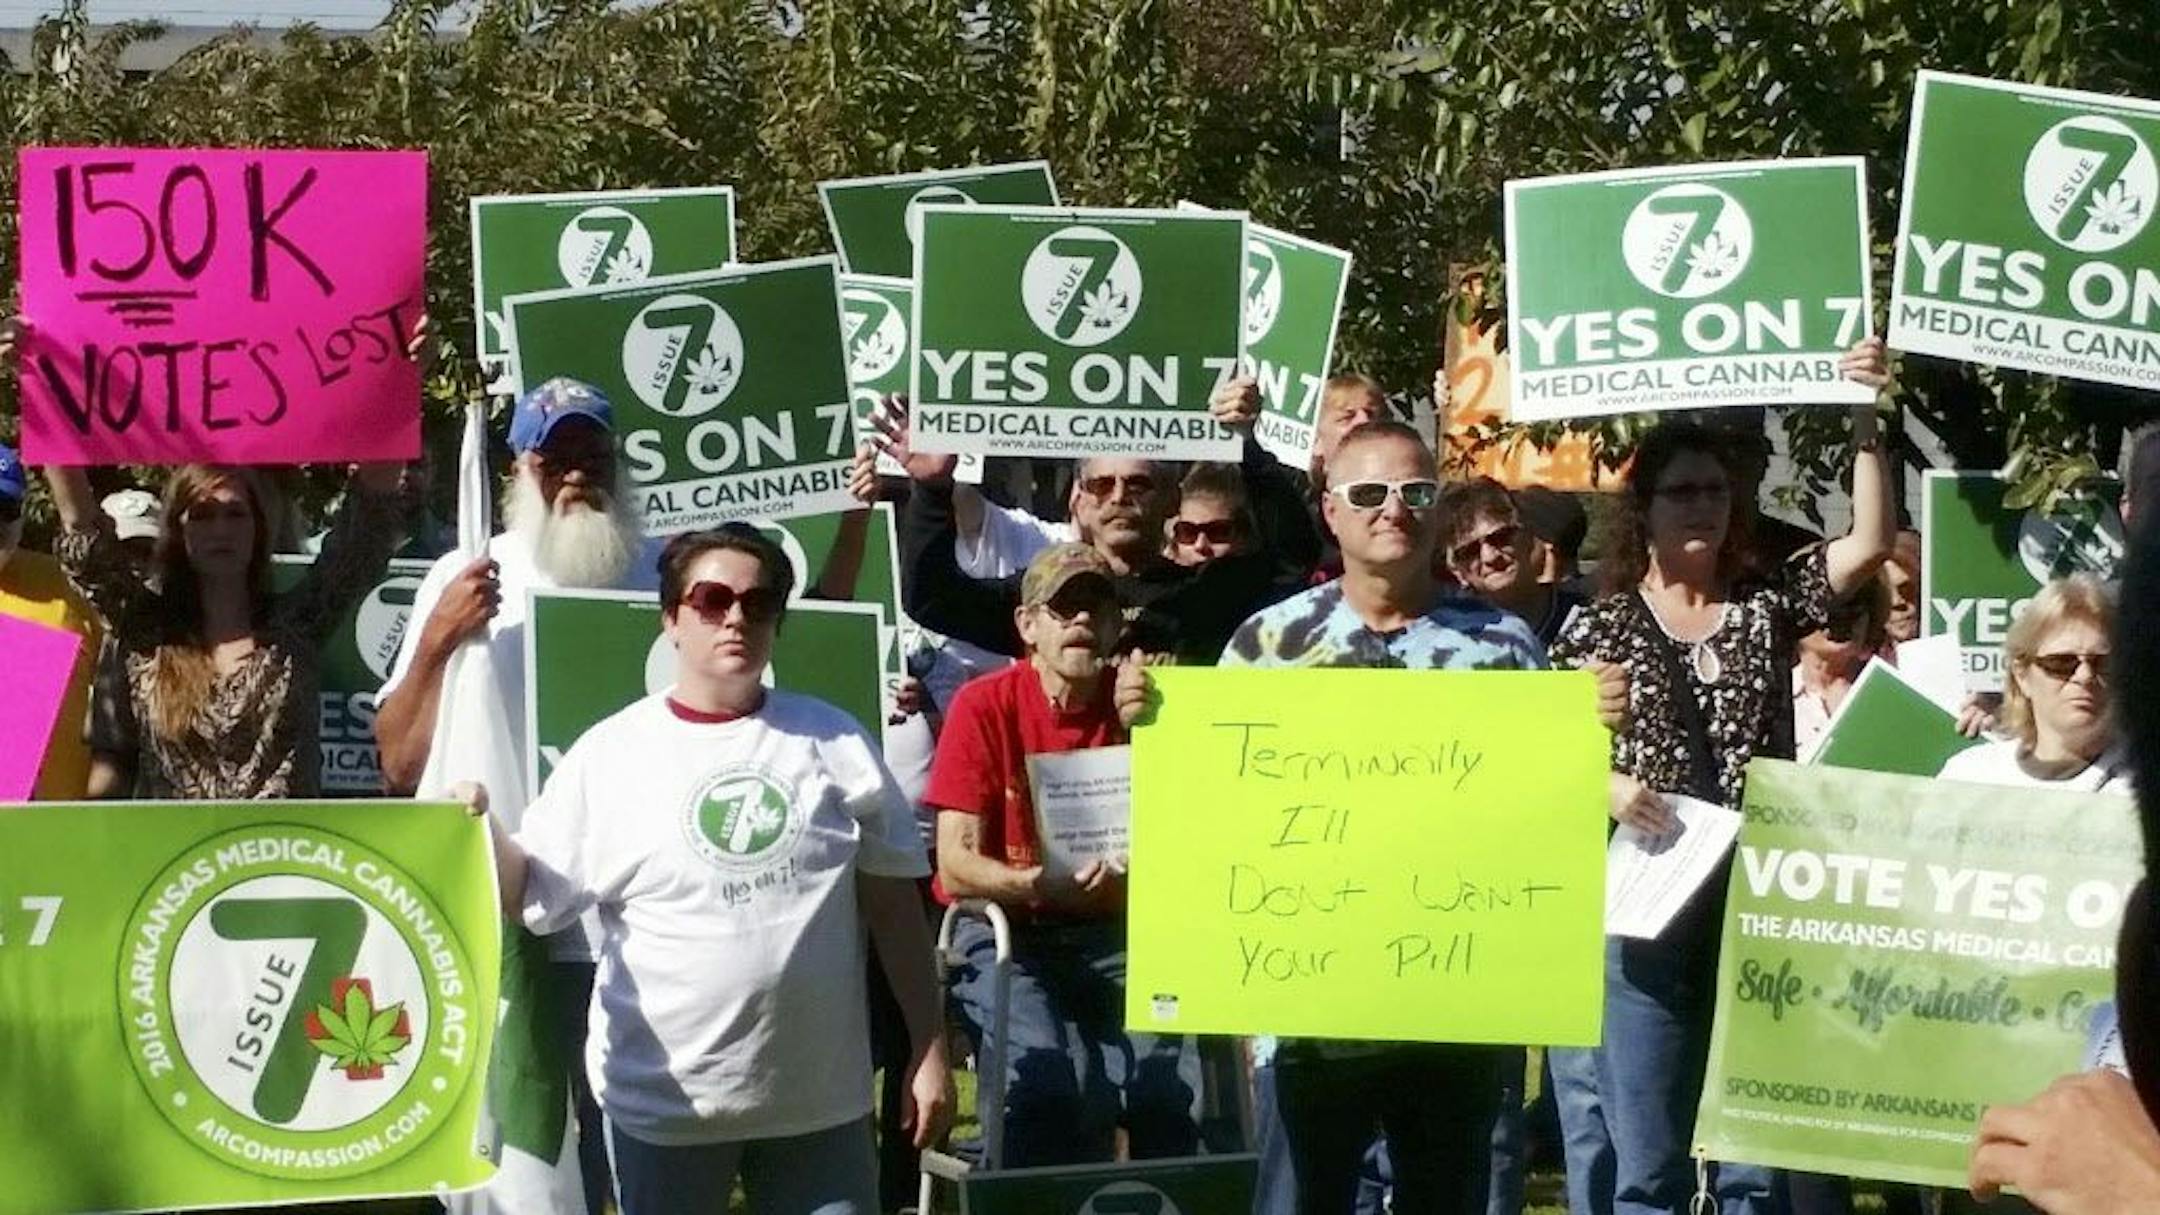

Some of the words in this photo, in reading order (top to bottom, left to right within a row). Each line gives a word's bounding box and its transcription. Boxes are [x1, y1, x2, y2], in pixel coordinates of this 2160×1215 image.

[2048, 157, 2094, 215] ISSUE
[2057, 126, 2138, 242] 7
[53, 161, 217, 282] 150
[243, 160, 336, 302] K
[579, 237, 606, 279] ISSUE
[1648, 194, 1726, 293] 7
[1650, 220, 1686, 273] ISSUE
[1047, 264, 1085, 318] ISSUE
[1049, 238, 1121, 341] 7
[1908, 233, 2046, 309] YES
[643, 303, 716, 412] 7
[1520, 307, 1659, 367] YES
[1681, 298, 1802, 354] ON
[1824, 297, 1864, 349] 7
[1900, 303, 2050, 350] MEDICAL
[37, 338, 288, 437] VOTES
[652, 332, 683, 392] ISSUE
[920, 349, 1050, 404] YES
[1070, 352, 1179, 406] ON
[1521, 366, 1673, 400] MEDICAL
[1971, 342, 2160, 382] WWW.ARCOMPASSION.CO
[918, 410, 1058, 437] MEDICAL
[1069, 415, 1235, 442] CANNABIS
[1297, 372, 1322, 420] 7
[1598, 385, 1793, 407] WWW.ARCOMPASSION.COM
[685, 410, 798, 474] ON
[815, 402, 850, 456] 7
[988, 438, 1167, 453] WWW.ARCOMPASSION.COM
[709, 780, 765, 853] 7
[216, 836, 349, 875] MEDICAL
[1741, 847, 1907, 909] VOTE
[1925, 864, 2048, 924] YES
[21, 895, 64, 946] 7
[131, 857, 217, 1008] ARKANSAS
[353, 860, 464, 998] CANNABIS
[1738, 912, 1782, 939] THE
[1785, 917, 1926, 951] ARKANSAS
[1931, 930, 2057, 965] MEDICAL
[1385, 933, 1474, 979] Pill
[210, 897, 368, 1125] 7
[227, 953, 297, 1073] ISSUE
[1737, 958, 1804, 1021] Safe
[1832, 967, 2021, 1034] Affordable
[134, 1011, 175, 1079] 2016
[440, 1001, 469, 1066] ACT
[1725, 1077, 1831, 1107] SPONSORED
[1836, 1090, 1857, 1109] BY
[1862, 1093, 1976, 1121] ARKANSANS
[196, 1101, 432, 1169] ARCOMPASSION.COM
